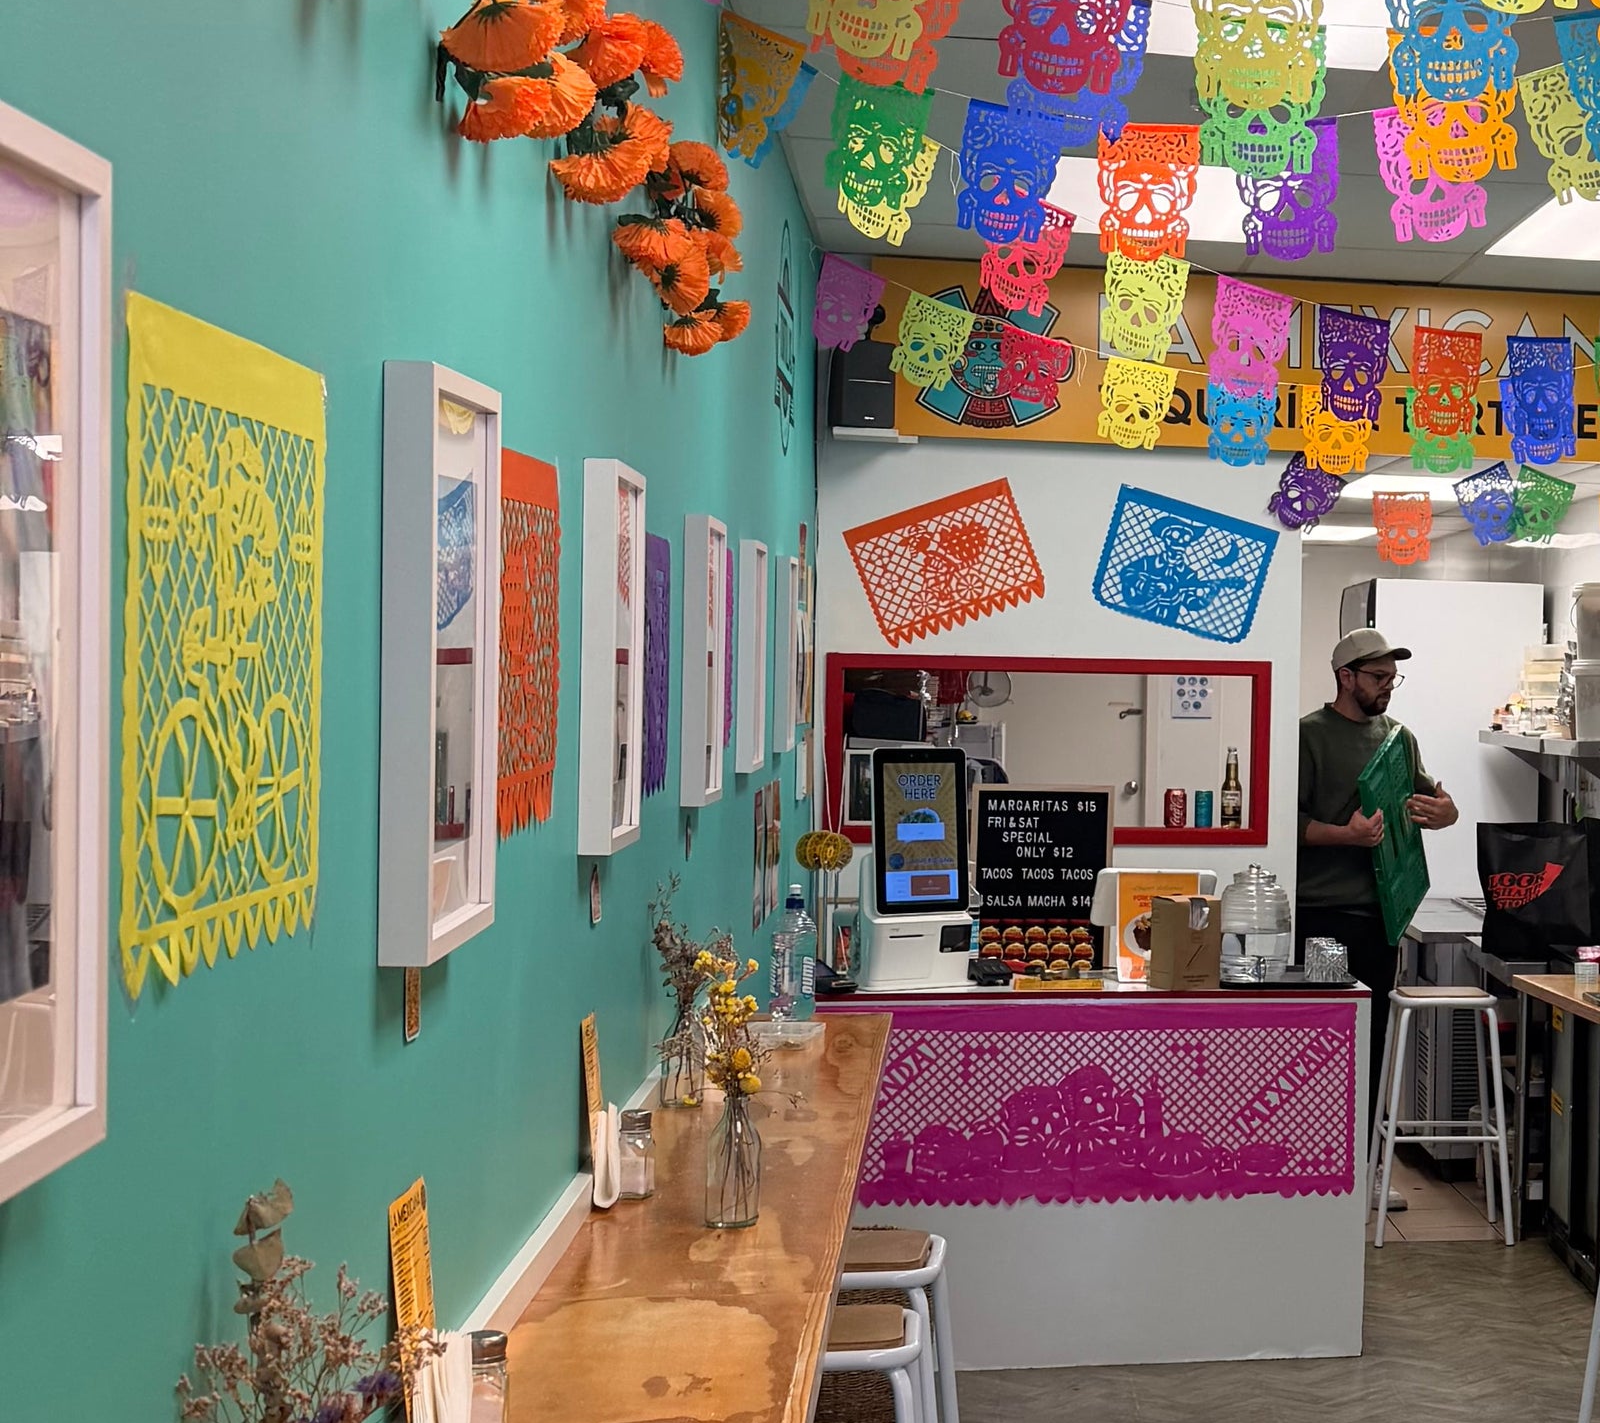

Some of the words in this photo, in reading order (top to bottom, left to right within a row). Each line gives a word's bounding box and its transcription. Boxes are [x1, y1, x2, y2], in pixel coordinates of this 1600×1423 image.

[897, 773, 942, 786] ORDER
[904, 787, 937, 800] HERE
[987, 799, 1069, 812] MARGARITAS
[1077, 800, 1097, 812] $15
[987, 816, 1006, 828] FRI
[1018, 817, 1040, 828] SAT
[1002, 831, 1054, 843] SPECIAL
[1016, 846, 1046, 858] ONLY
[1053, 846, 1074, 858] $12
[981, 867, 1013, 879] TACOS
[1021, 868, 1054, 880] TACOS
[1060, 868, 1094, 880] TACOS
[1027, 895, 1066, 907] MACHA
[802, 956, 816, 996] pump
